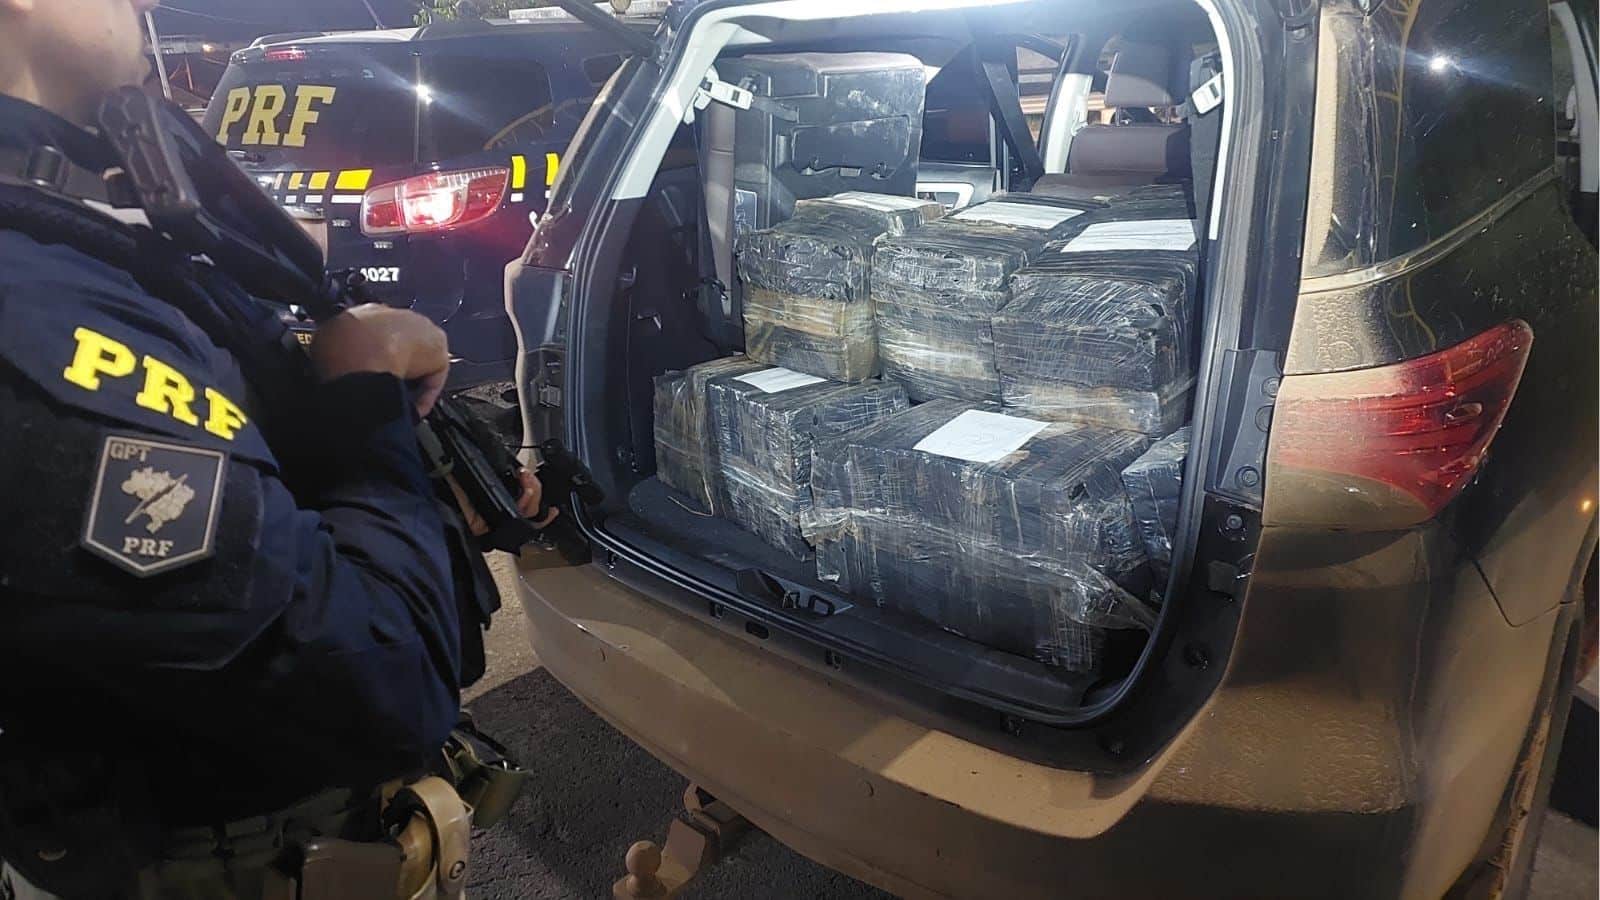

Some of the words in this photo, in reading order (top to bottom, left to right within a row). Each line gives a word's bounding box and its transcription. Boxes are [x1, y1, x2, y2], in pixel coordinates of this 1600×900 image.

[215, 84, 336, 147] PRF
[63, 327, 247, 440] PRF
[110, 442, 152, 462] GPT
[122, 536, 174, 557] PRF
